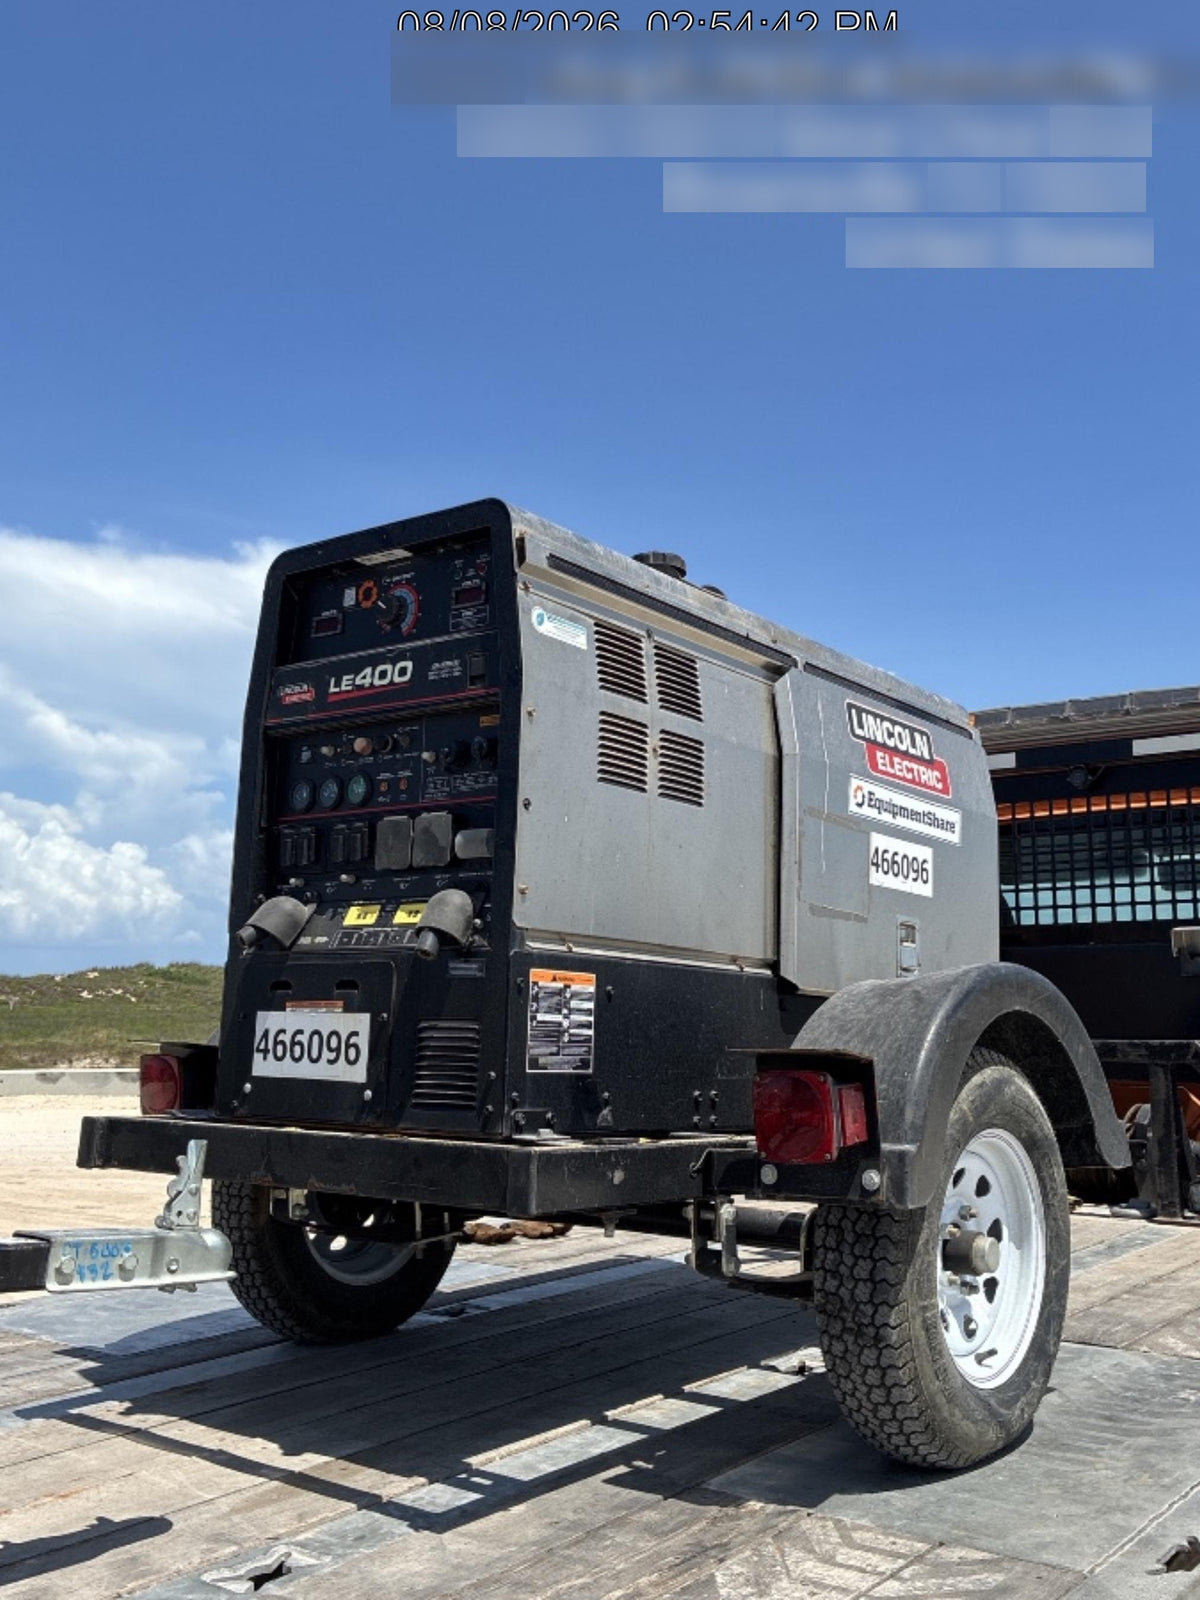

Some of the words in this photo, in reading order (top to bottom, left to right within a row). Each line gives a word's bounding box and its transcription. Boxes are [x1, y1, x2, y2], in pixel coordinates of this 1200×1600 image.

[328, 660, 413, 694] LE400
[851, 708, 931, 760] LINCOLN
[875, 750, 944, 791] ELECTRIC
[867, 790, 956, 834] EquipmentShare
[871, 846, 930, 885] 466096
[255, 1028, 362, 1066] 466096
